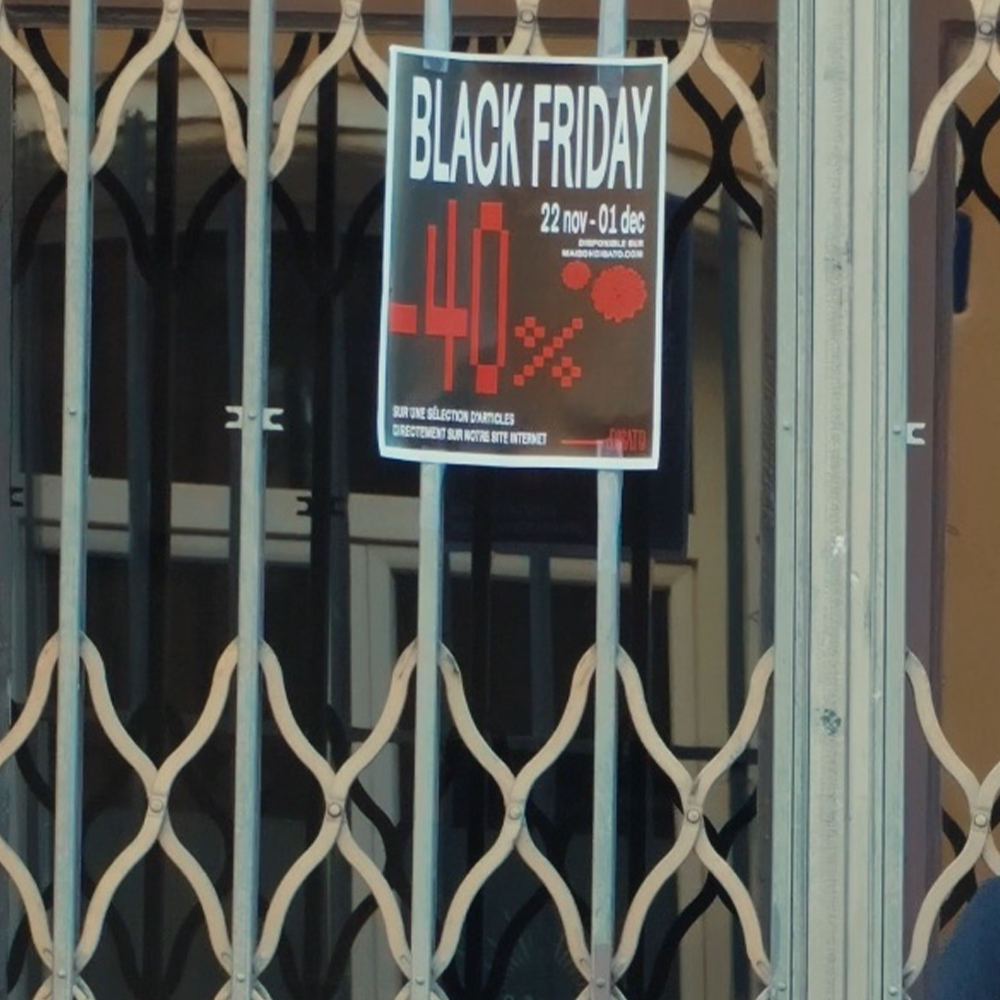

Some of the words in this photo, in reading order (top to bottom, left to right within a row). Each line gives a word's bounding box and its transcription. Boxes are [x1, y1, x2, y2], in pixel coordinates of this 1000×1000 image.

[410, 76, 523, 187] BLACK
[531, 84, 653, 189] FRIDAY
[540, 202, 560, 233] 22
[563, 210, 588, 234] nov
[598, 203, 618, 234] 01
[620, 204, 645, 234] dec
[392, 405, 408, 418] SUR
[409, 406, 426, 420] UNE
[426, 405, 468, 423] SÉLECTION
[447, 427, 463, 441] SUR
[464, 429, 490, 442] NOTRE
[491, 430, 509, 444] SITE
[510, 432, 547, 446] INTERNET
